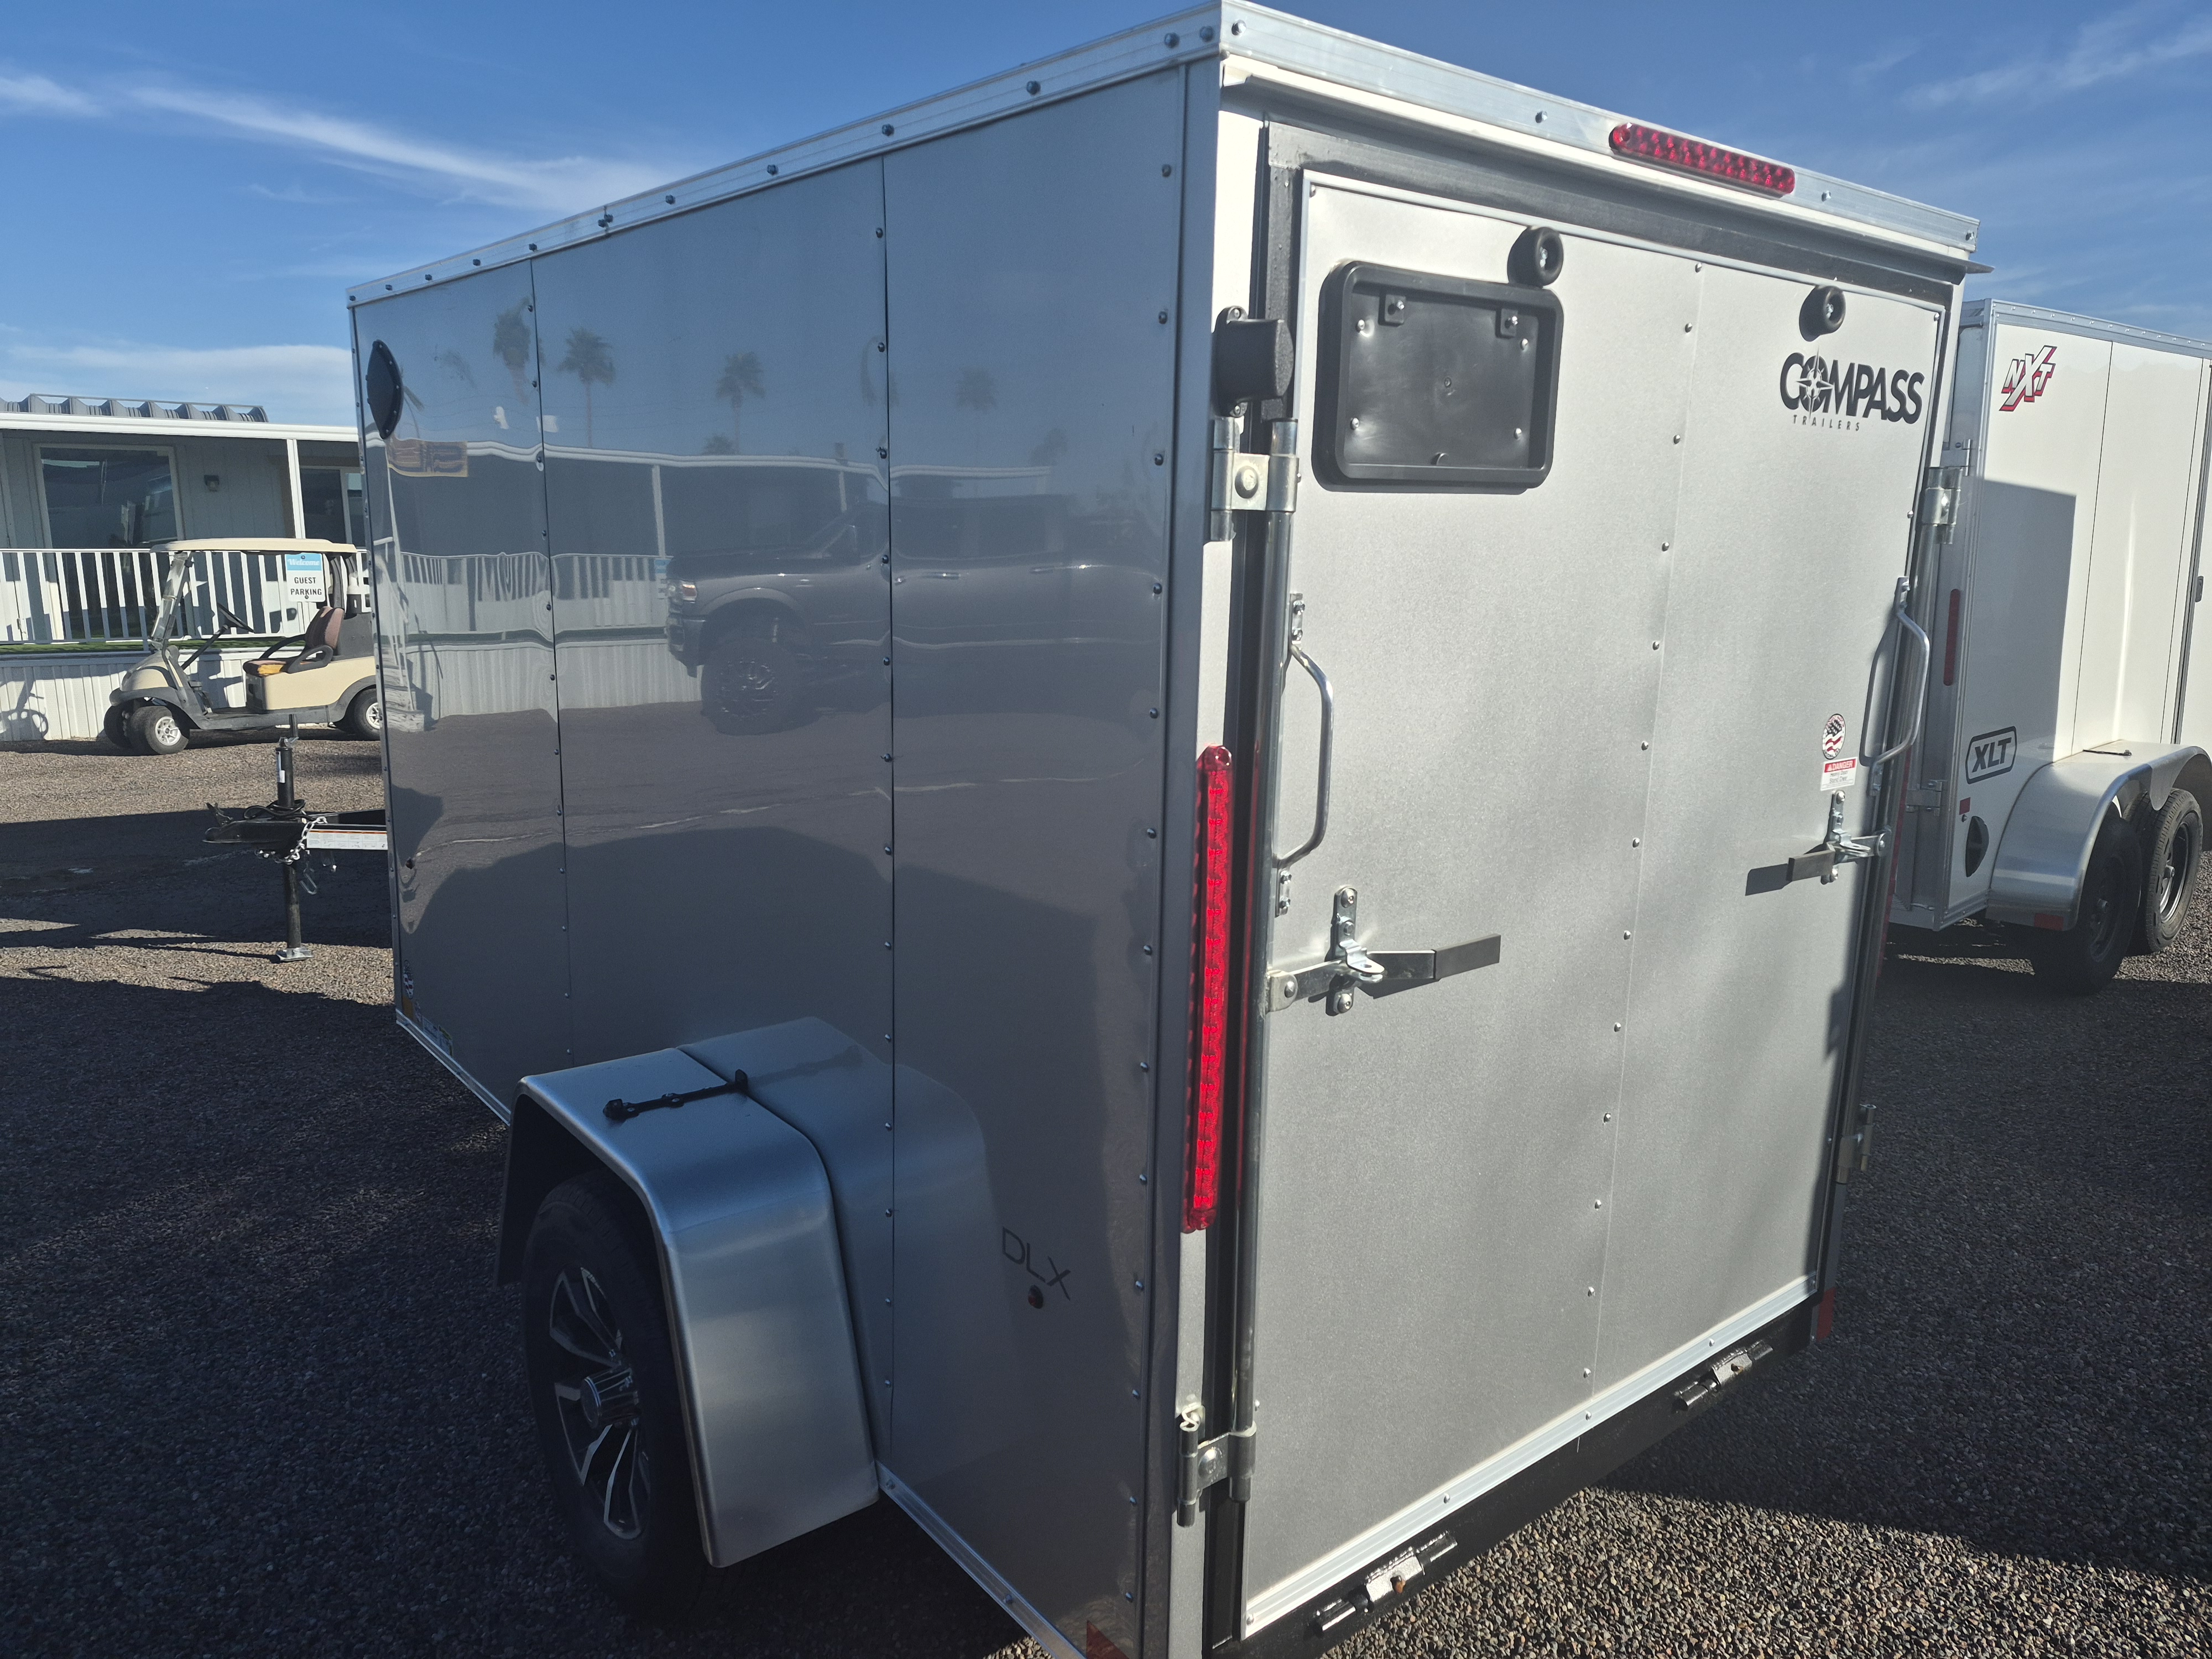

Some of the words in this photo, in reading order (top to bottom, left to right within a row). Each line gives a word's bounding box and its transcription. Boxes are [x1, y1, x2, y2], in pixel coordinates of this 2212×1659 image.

[1780, 352, 1925, 424] COMPASS
[1999, 345, 2058, 412] NXT
[1792, 415, 1861, 431] TRAILERS
[287, 558, 320, 566] Welcome
[1832, 760, 1853, 770] DANGER
[1971, 737, 2012, 773] XLT
[1001, 1226, 1071, 1301] DLX
